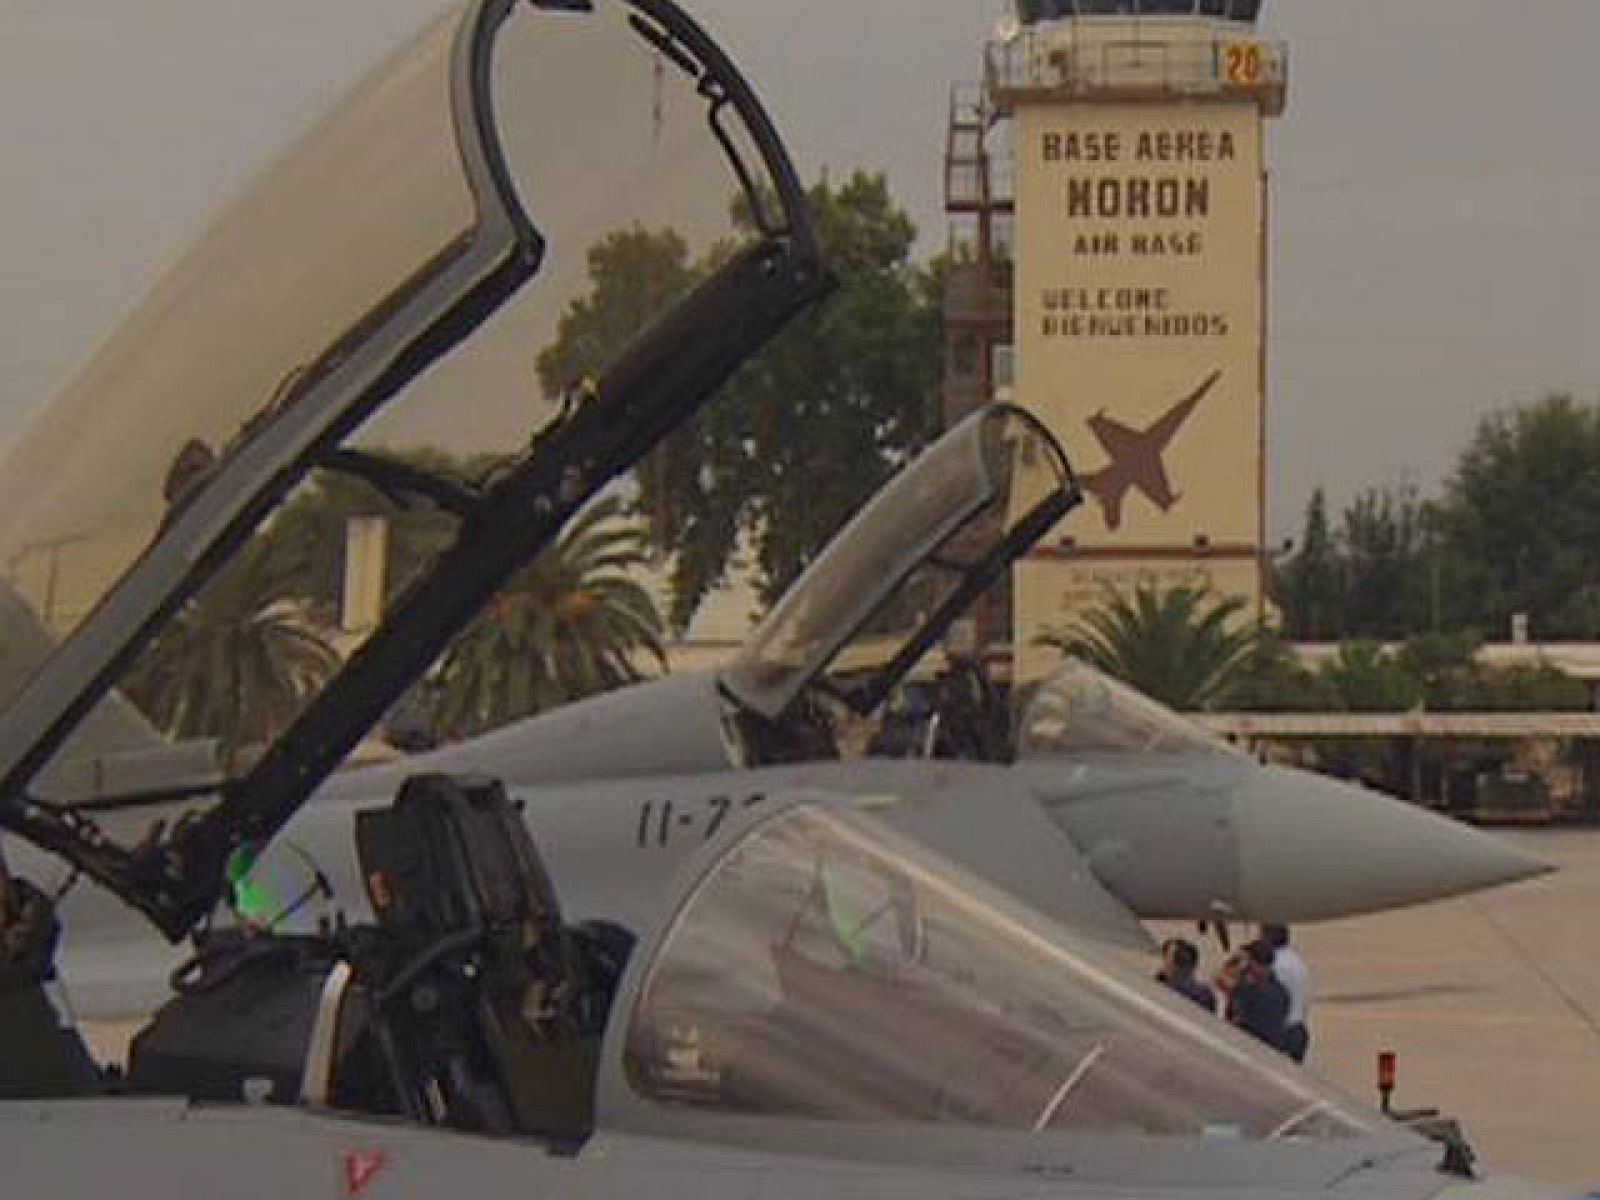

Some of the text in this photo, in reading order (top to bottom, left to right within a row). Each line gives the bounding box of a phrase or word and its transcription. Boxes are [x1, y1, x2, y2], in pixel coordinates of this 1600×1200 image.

[1042, 131, 1235, 161] BASE AEREA
[1067, 177, 1209, 218] MORON
[1073, 232, 1202, 255] AIR BASE
[637, 792, 767, 848] 11-7
